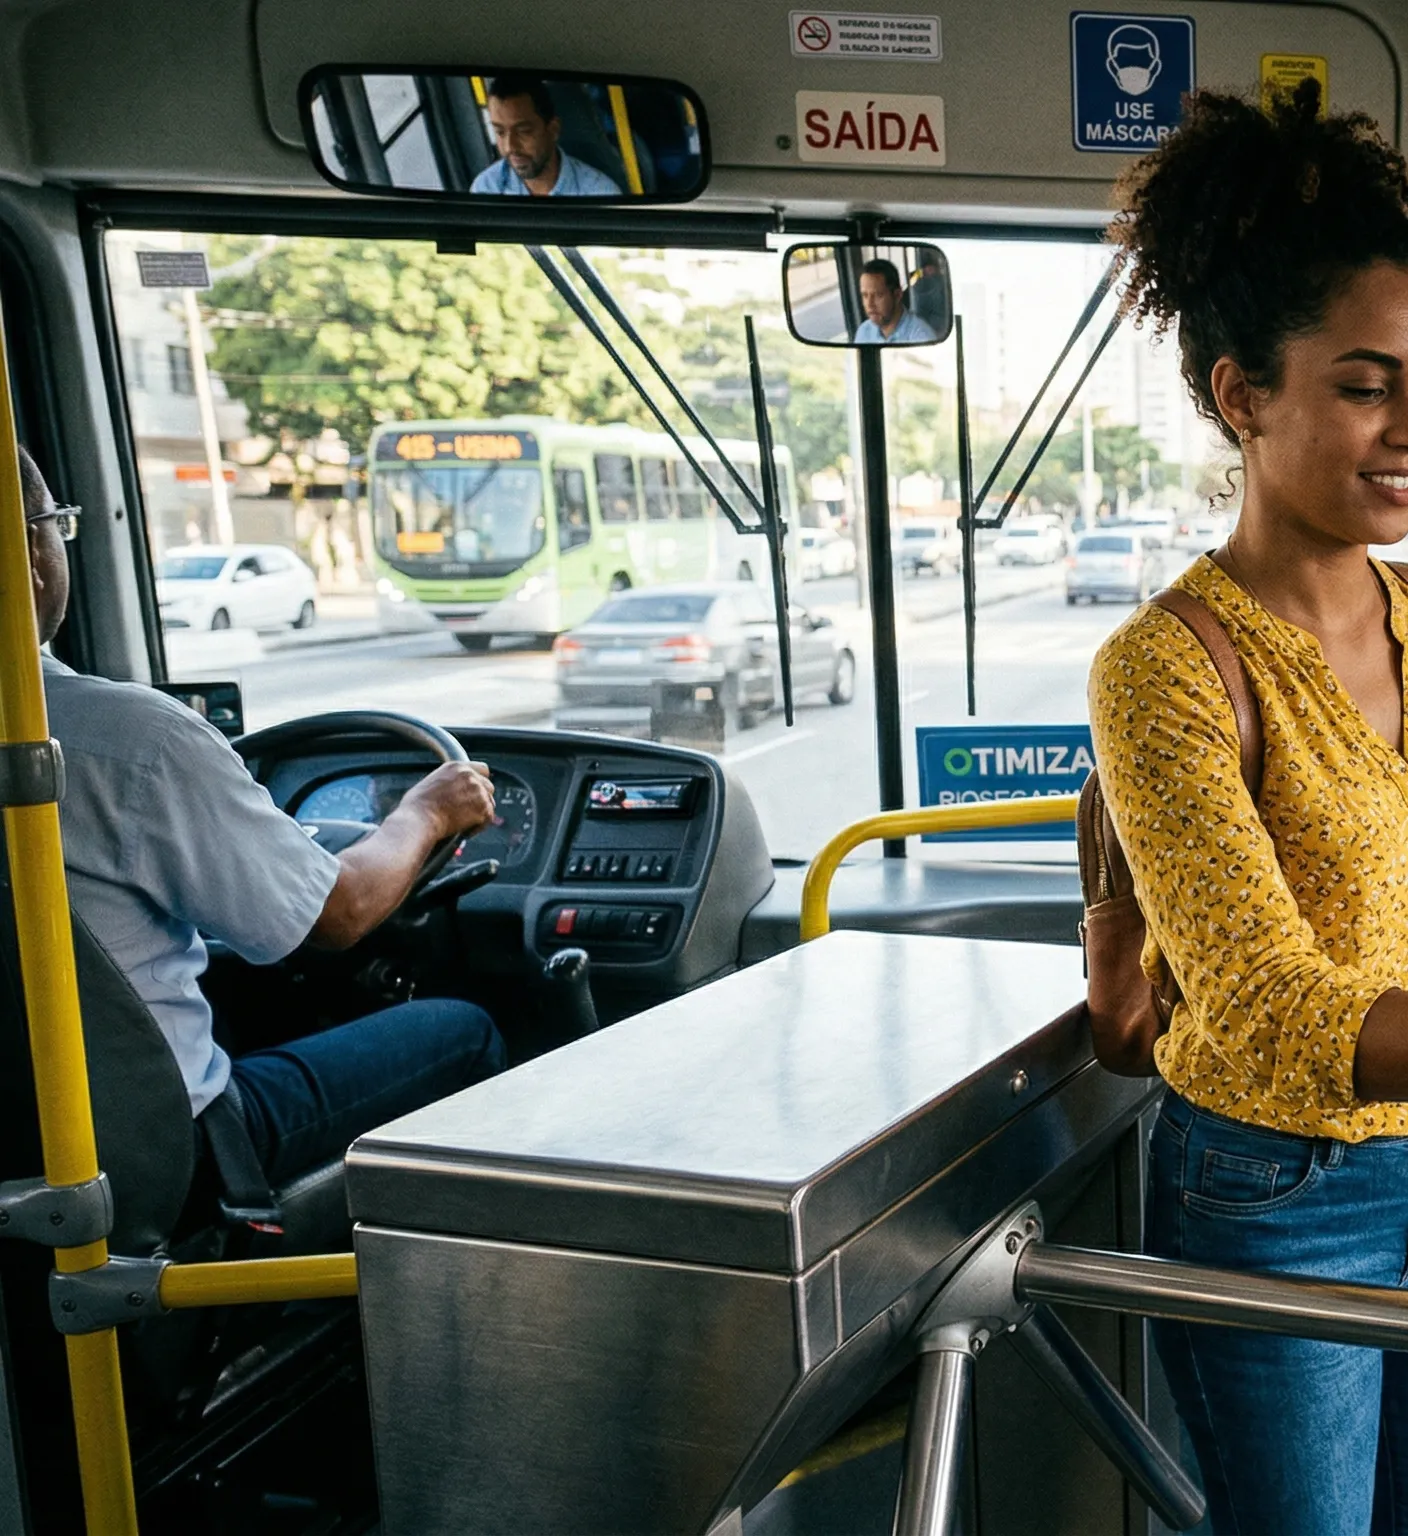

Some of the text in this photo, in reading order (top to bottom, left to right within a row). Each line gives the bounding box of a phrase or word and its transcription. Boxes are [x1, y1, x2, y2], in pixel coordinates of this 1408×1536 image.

[1115, 101, 1155, 120] USE
[805, 101, 940, 152] SAÍDA
[943, 746, 1096, 776] OTIMIZA
